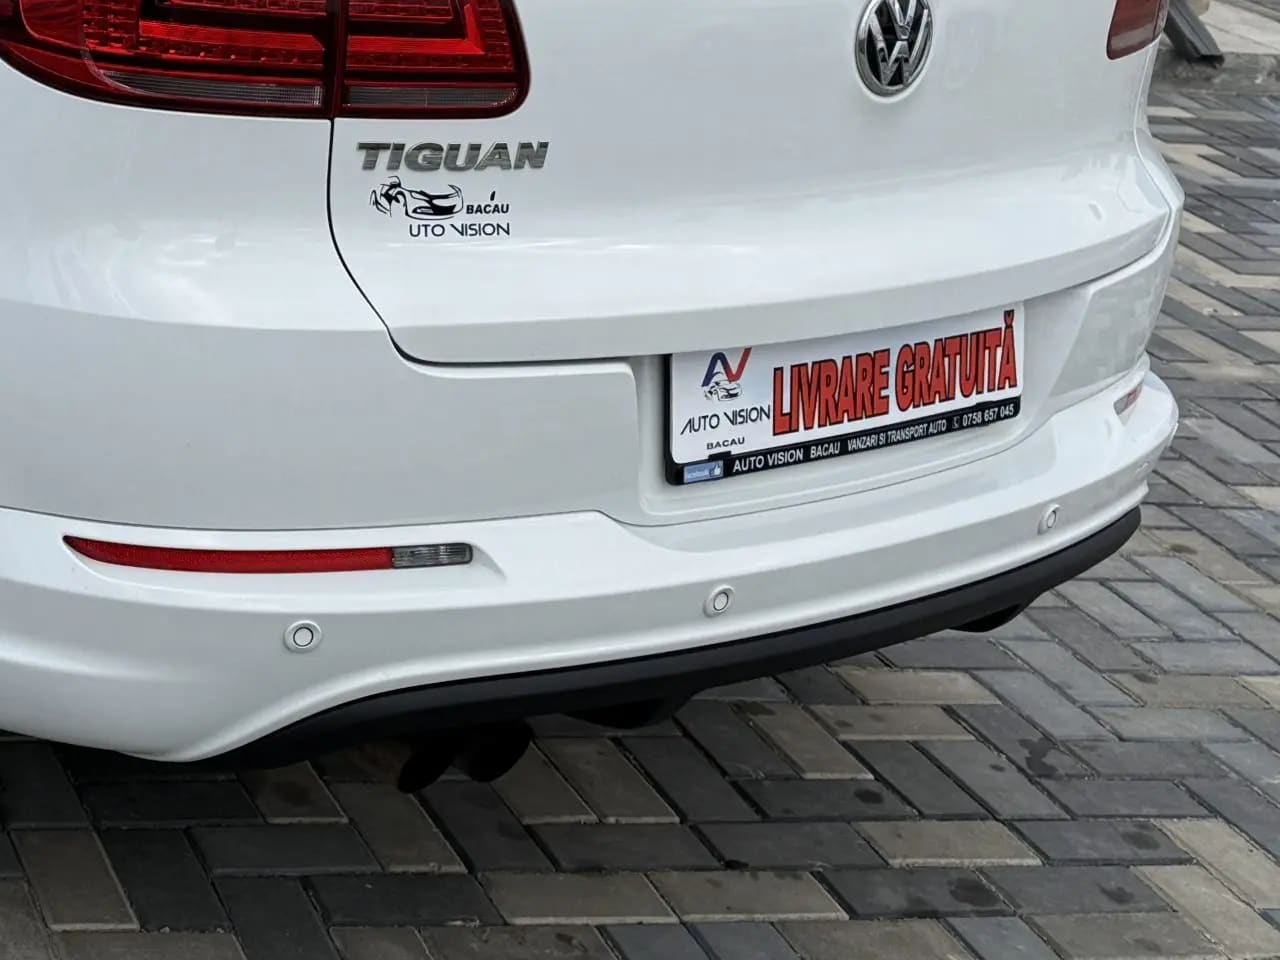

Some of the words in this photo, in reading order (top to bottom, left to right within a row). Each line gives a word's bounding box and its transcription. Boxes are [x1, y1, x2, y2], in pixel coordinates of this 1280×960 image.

[356, 141, 550, 172] TIGUAN
[450, 222, 510, 237] VISION
[772, 347, 891, 436] LIVRARE
[894, 310, 1018, 412] GRATUITĂ
[680, 413, 720, 435] AUTO
[723, 404, 771, 426] VISION
[706, 437, 745, 450] BACAU
[733, 455, 764, 473] AUTO
[767, 448, 804, 467] VISION
[810, 442, 841, 459] BACAU
[847, 433, 878, 452] VANZARI
[879, 431, 886, 445] SI
[887, 424, 928, 444] TRANSPORT
[928, 419, 947, 434] AUTO
[962, 412, 982, 427] 0758
[984, 407, 999, 422] 657
[1000, 403, 1015, 418] 045
